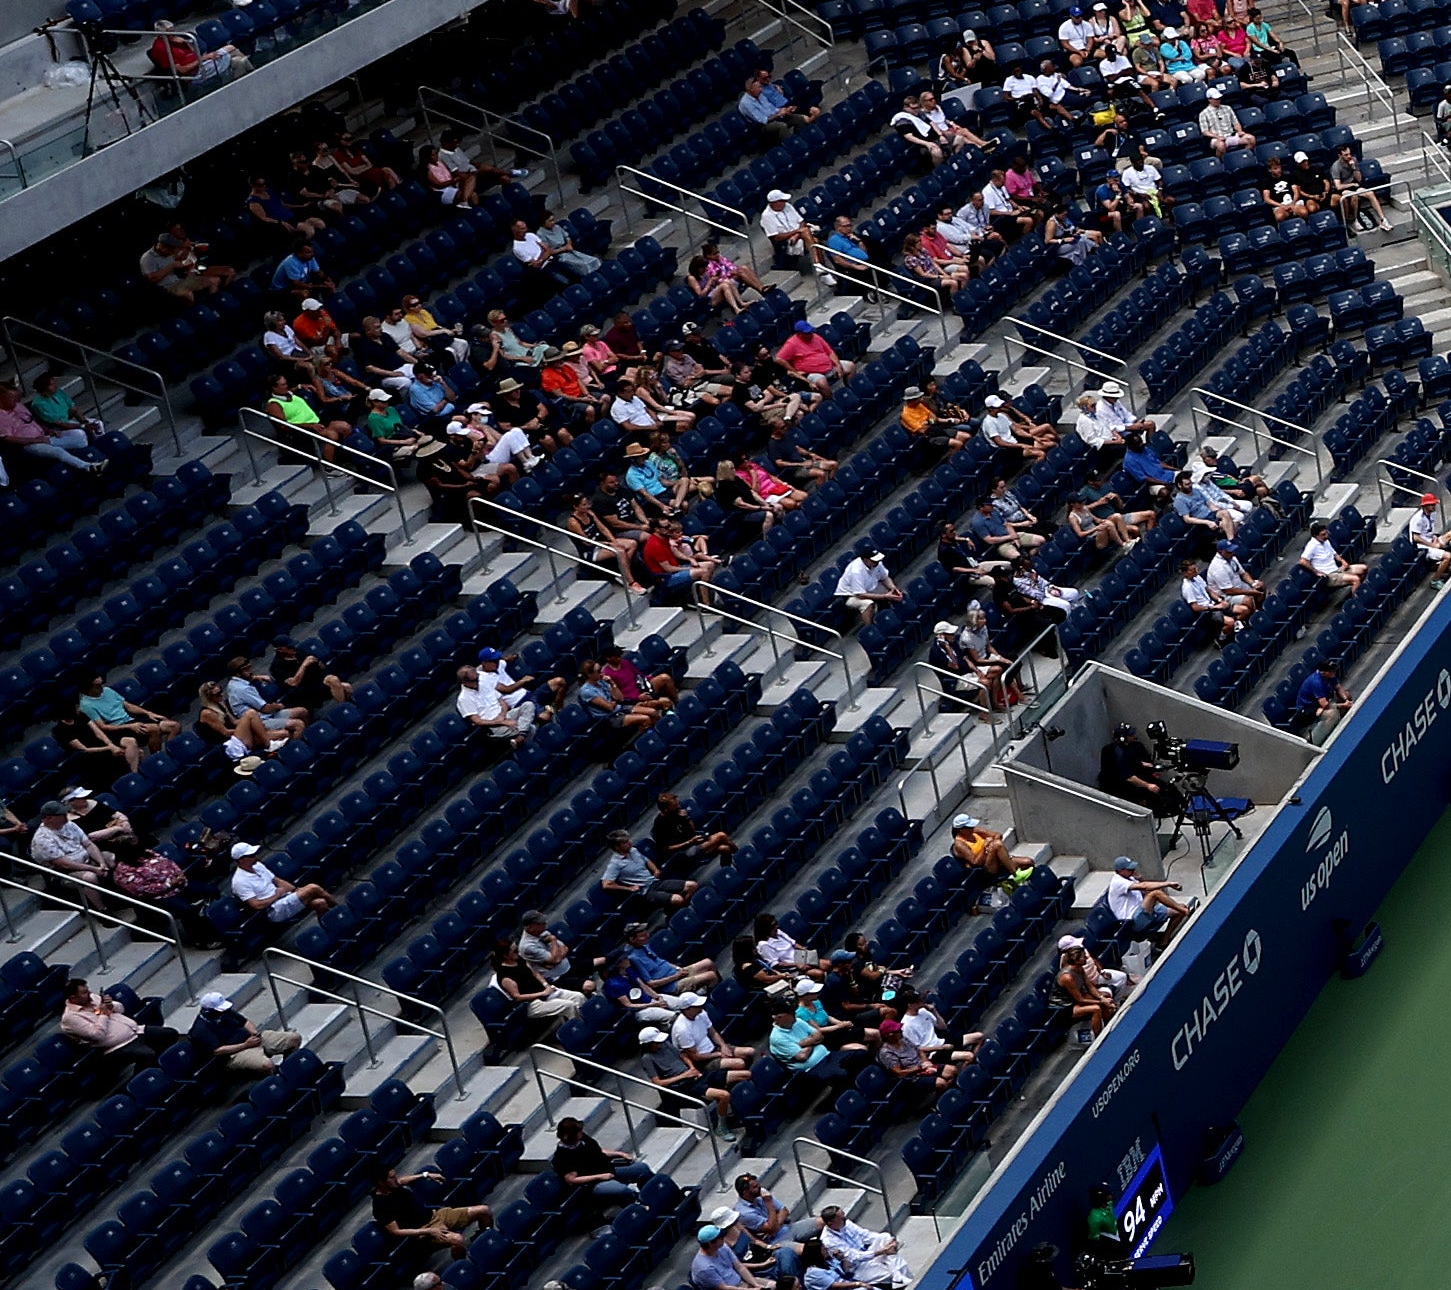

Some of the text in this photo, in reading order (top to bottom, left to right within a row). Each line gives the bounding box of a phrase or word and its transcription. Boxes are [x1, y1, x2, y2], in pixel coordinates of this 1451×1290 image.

[1381, 689, 1437, 784] CHASE
[1170, 954, 1243, 1071] CHASE
[1092, 1049, 1141, 1119] USOPEN.ORG
[1117, 1137, 1146, 1191] IBM
[977, 1160, 1067, 1287] Emirates Airline
[1124, 1196, 1145, 1242] 94
